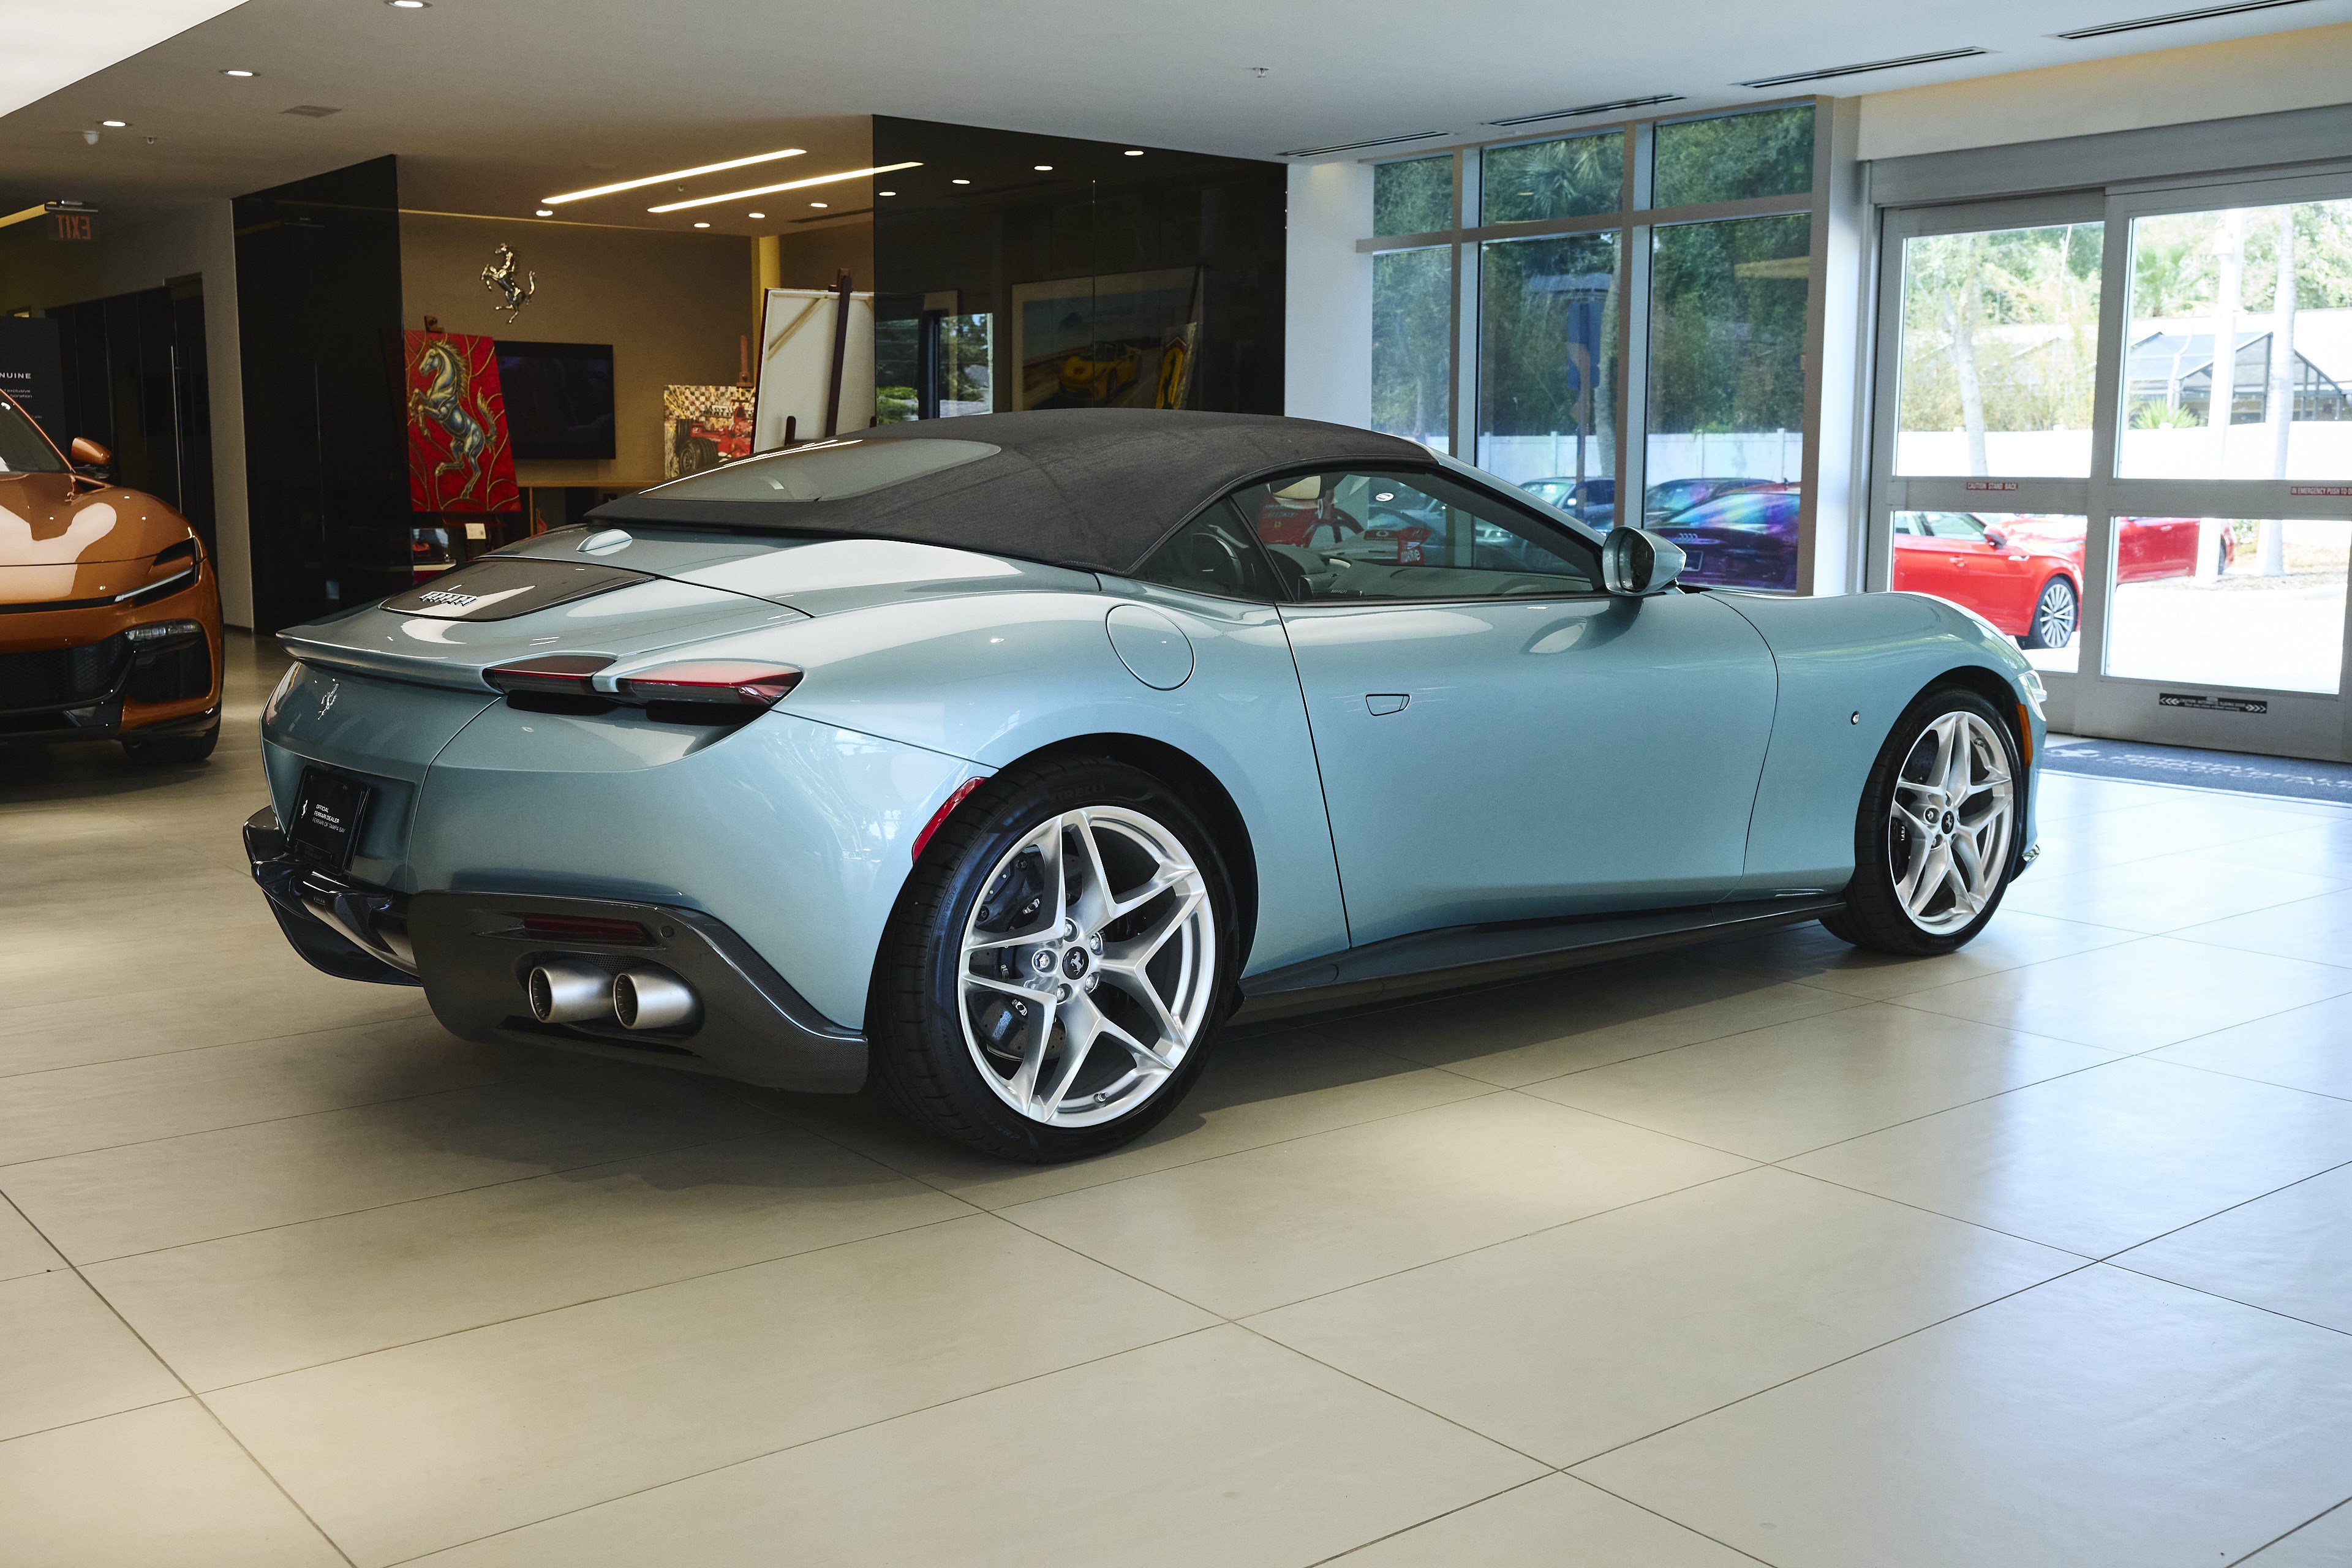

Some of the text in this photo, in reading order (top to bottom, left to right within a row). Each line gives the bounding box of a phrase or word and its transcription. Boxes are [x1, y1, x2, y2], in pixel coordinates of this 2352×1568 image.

[316, 804, 329, 813] OFFICIAL
[312, 817, 324, 826] FERRARI
[314, 810, 340, 824] FERRARI DEALER
